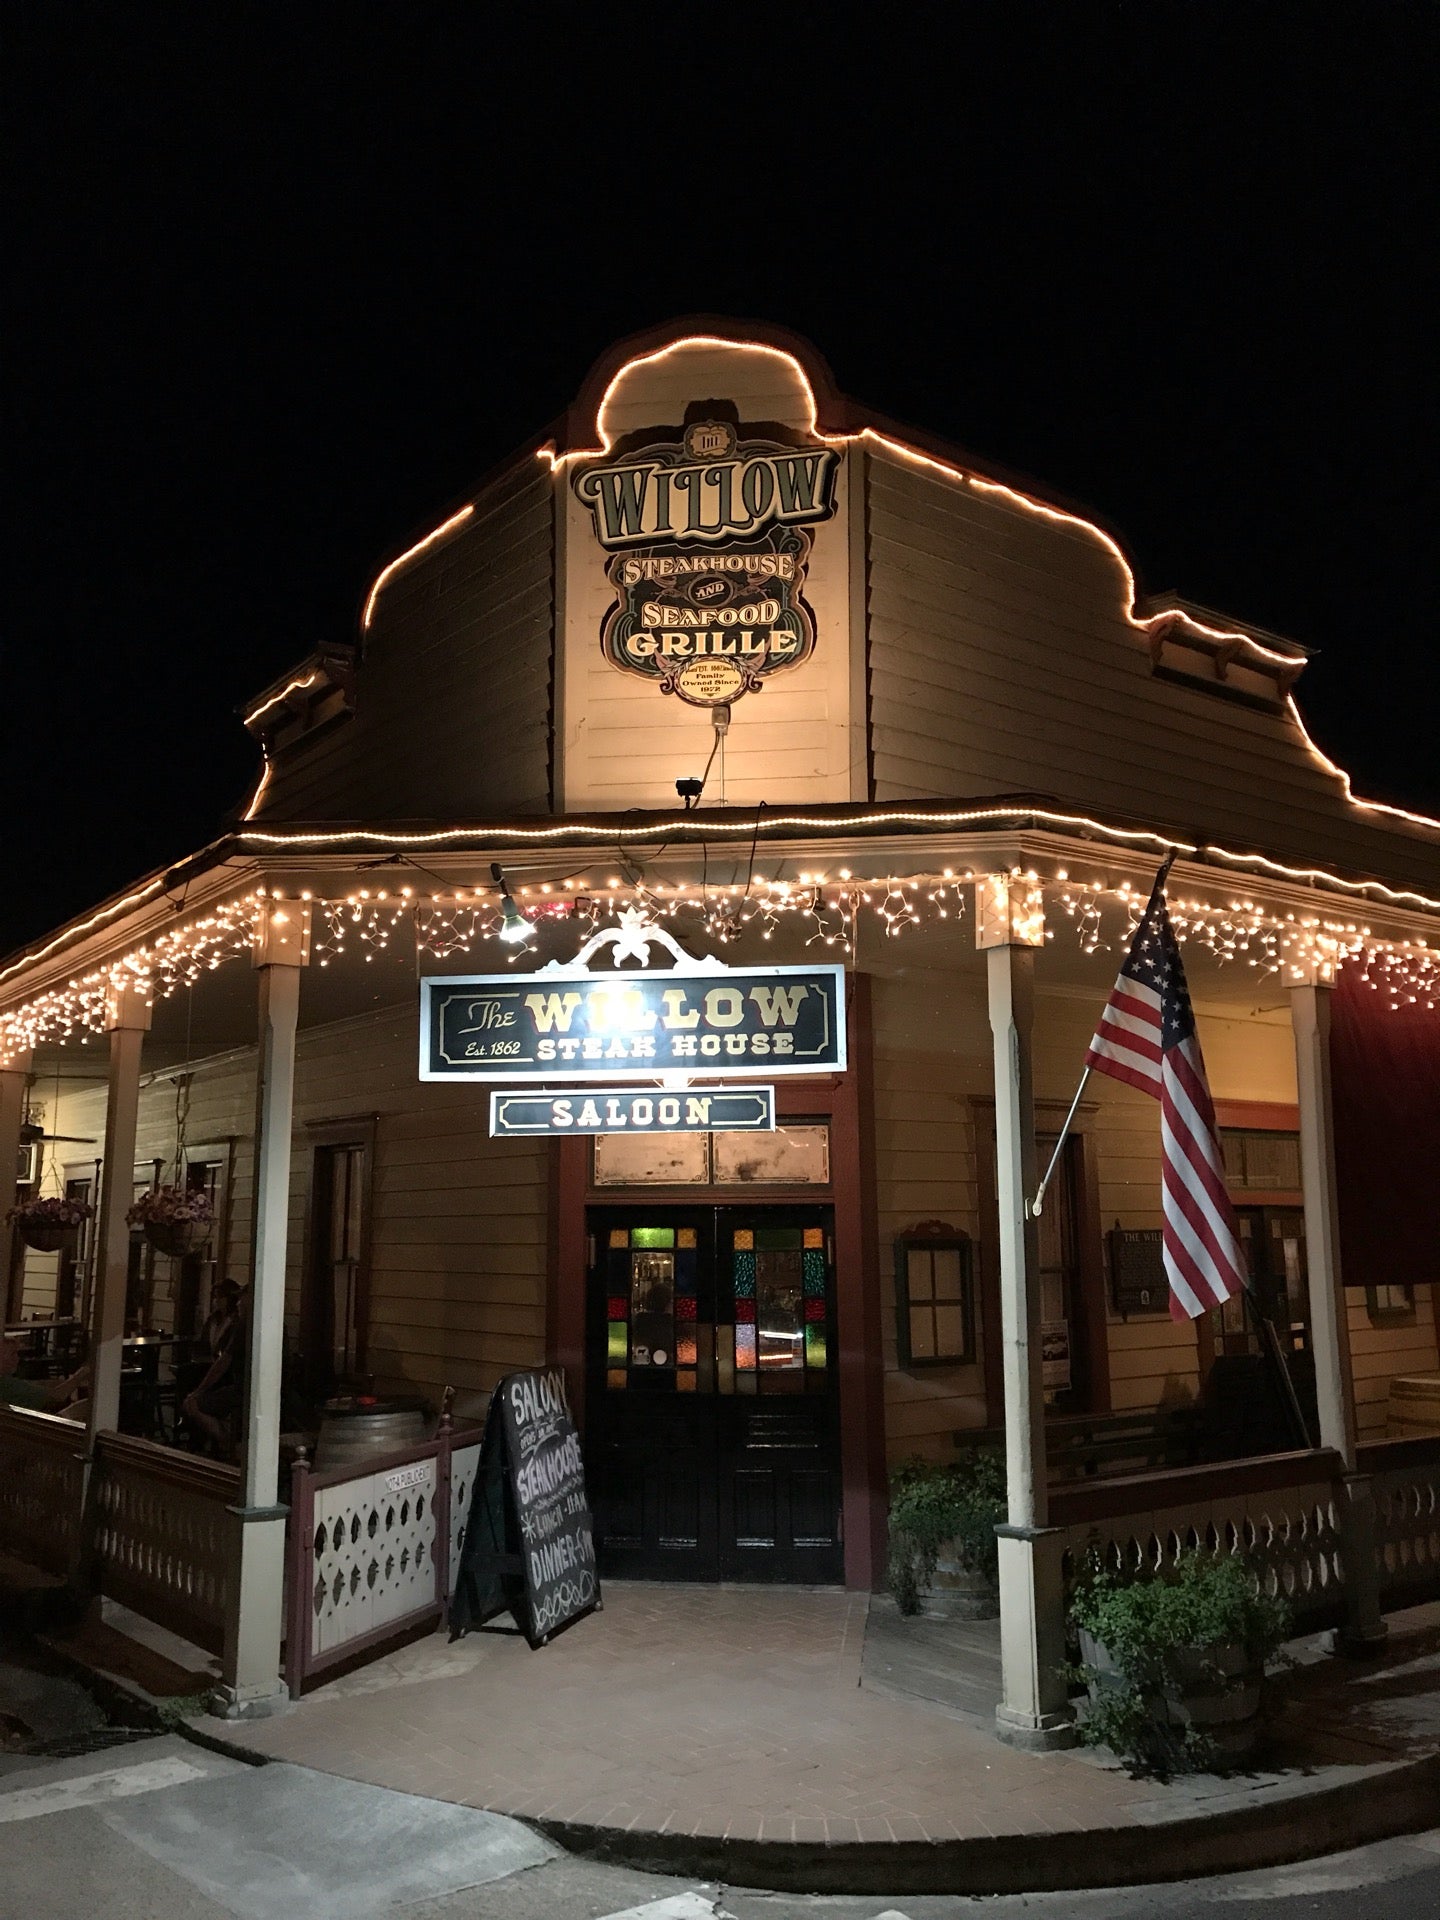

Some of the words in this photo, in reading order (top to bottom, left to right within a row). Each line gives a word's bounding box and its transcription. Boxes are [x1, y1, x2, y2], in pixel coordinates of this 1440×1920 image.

[584, 454, 825, 539] WILLOW
[624, 553, 796, 586] STEAKHOUSE
[695, 582, 725, 599] AND
[642, 599, 781, 628] SEAFOOD
[626, 630, 798, 657] GRILLE
[458, 1001, 518, 1034] The
[464, 1041, 488, 1056] Est.
[490, 1041, 521, 1055] 1862
[537, 1036, 656, 1060] STEAK
[671, 1032, 795, 1057] HOUSE
[552, 1097, 713, 1127] SALOON
[1124, 1232, 1140, 1242] THE
[511, 1368, 568, 1425] SALOON
[535, 1503, 564, 1540] LUNCH
